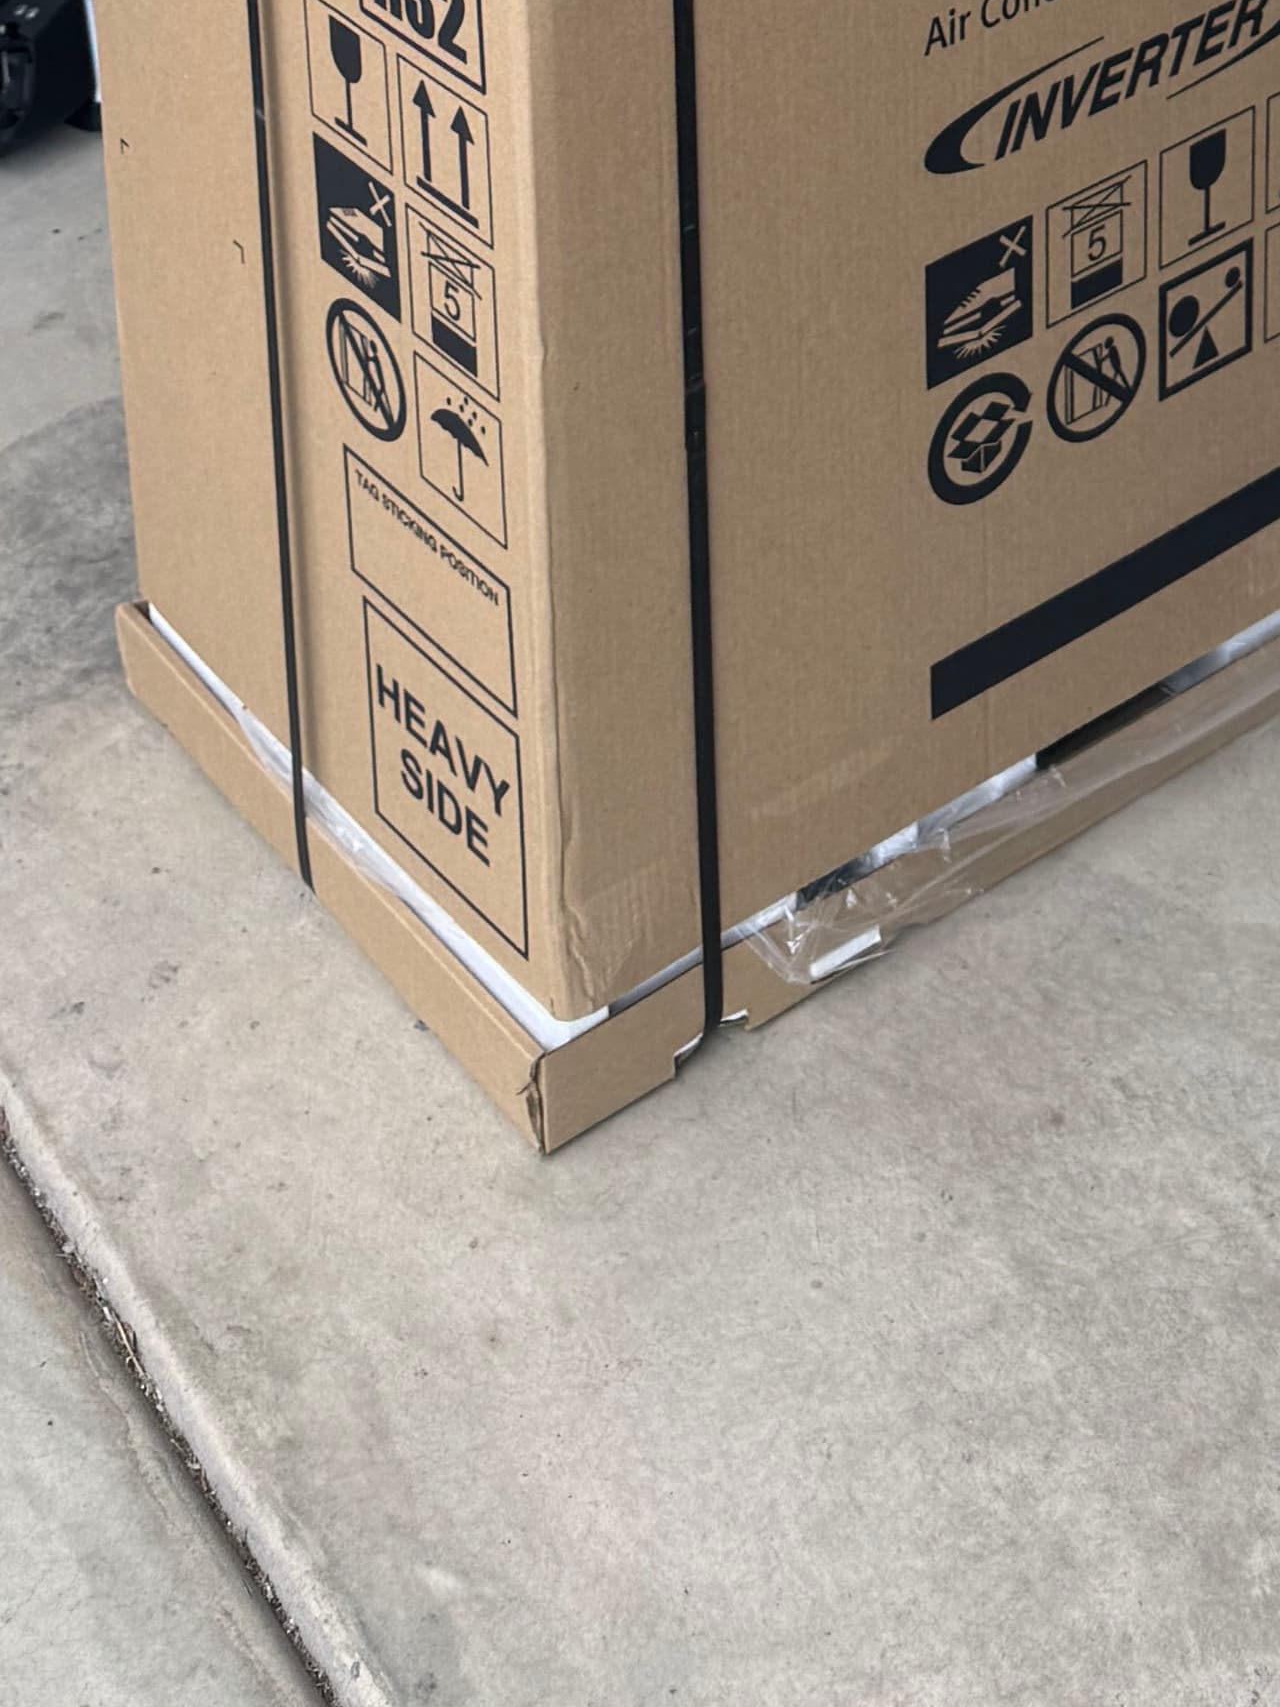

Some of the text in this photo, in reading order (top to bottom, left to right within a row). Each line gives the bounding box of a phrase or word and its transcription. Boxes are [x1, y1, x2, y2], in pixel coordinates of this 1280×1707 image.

[923, 8, 972, 57] Air
[1086, 223, 1108, 262] 5
[443, 279, 461, 322] 5
[354, 467, 500, 607] TAG STICKING POSITION
[375, 662, 511, 818] HEAVY
[400, 747, 491, 868] SIDE
